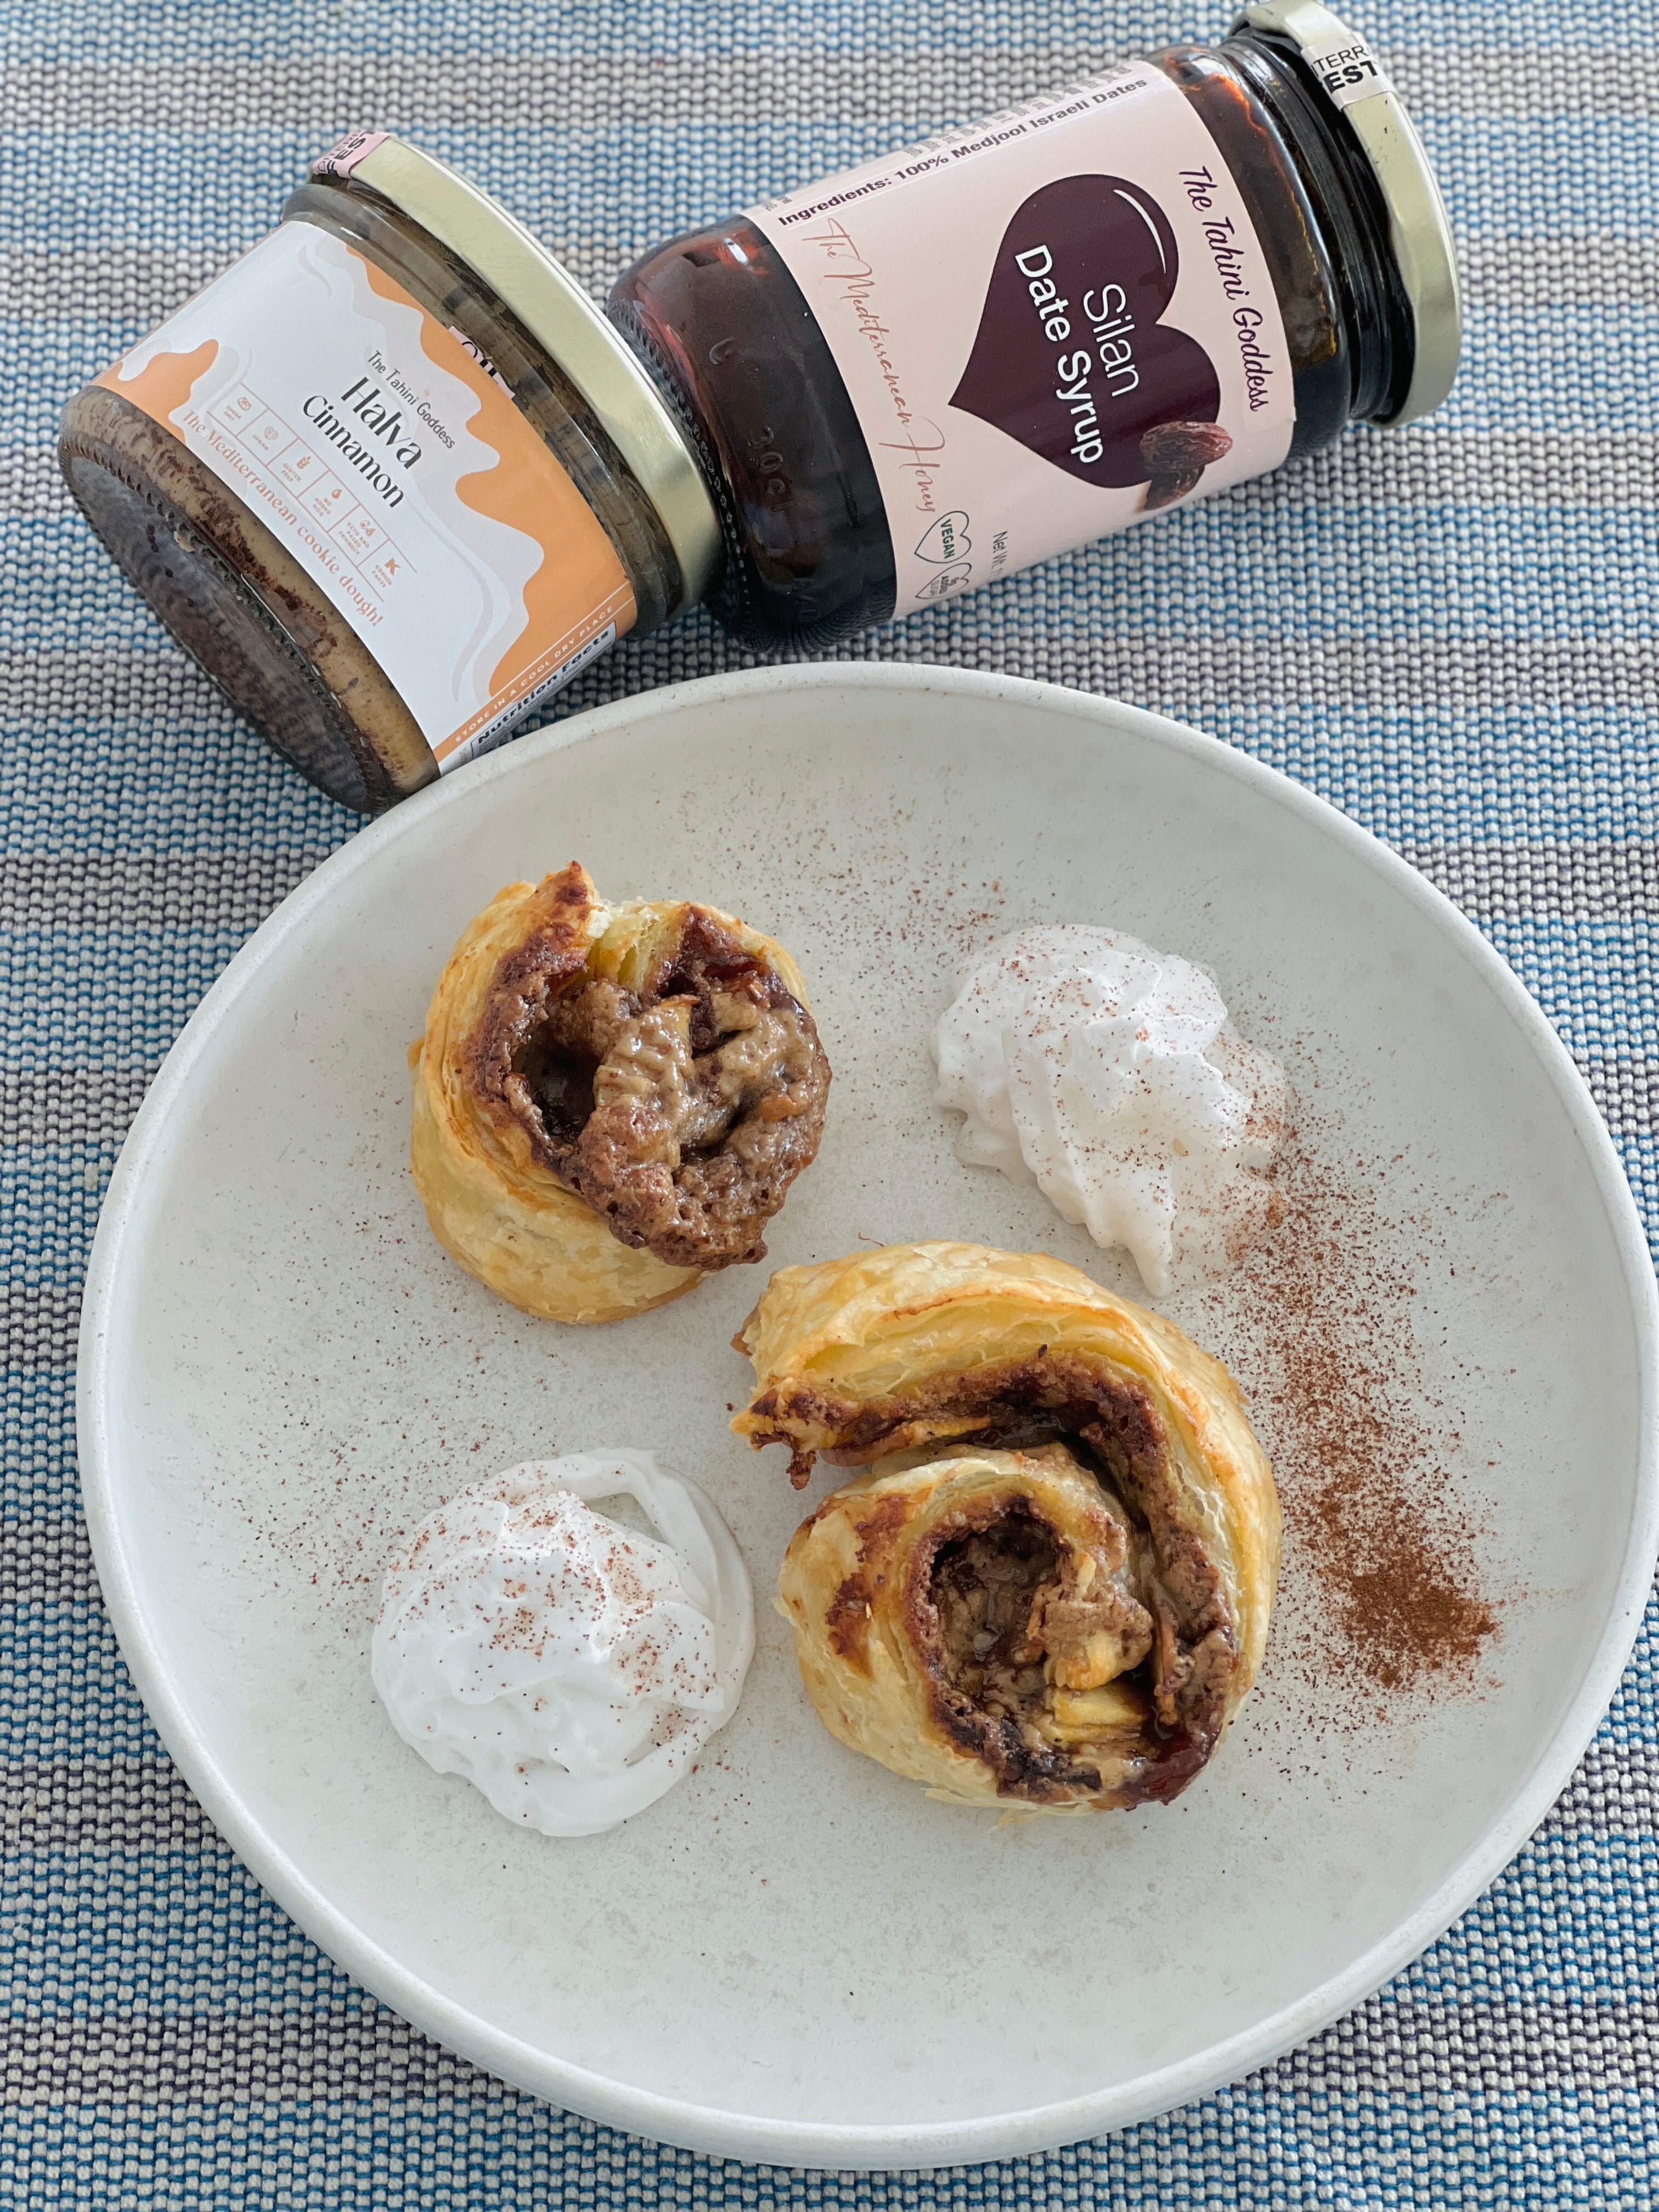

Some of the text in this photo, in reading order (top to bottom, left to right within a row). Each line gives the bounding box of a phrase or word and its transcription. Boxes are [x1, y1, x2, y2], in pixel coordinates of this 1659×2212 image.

[778, 177, 891, 226] Ingredients:
[895, 155, 949, 181] 100%
[951, 125, 1027, 159] Medjool
[1030, 100, 1089, 127] Israeli
[1094, 78, 1148, 104] Dates
[1084, 284, 1139, 397] Silan
[1178, 166, 1273, 411] The Tahini Goddess
[368, 350, 456, 449] The Tahini Goddess
[803, 218, 945, 512] The Mediterranean Honey
[1015, 245, 1103, 464] Date Syrup
[303, 395, 405, 508] Cinnamon
[341, 377, 423, 470] Halva
[183, 410, 384, 626] The Mediterranean cookie dough!
[940, 518, 955, 559] VEGAN
[993, 531, 1008, 553] Net
[455, 712, 490, 742] STORE
[494, 698, 505, 709] IN
[521, 660, 550, 686] COOL
[554, 637, 575, 659] DRY
[579, 606, 613, 637] PLACE
[478, 674, 558, 744] Nutrition
[561, 630, 610, 673] Facts
